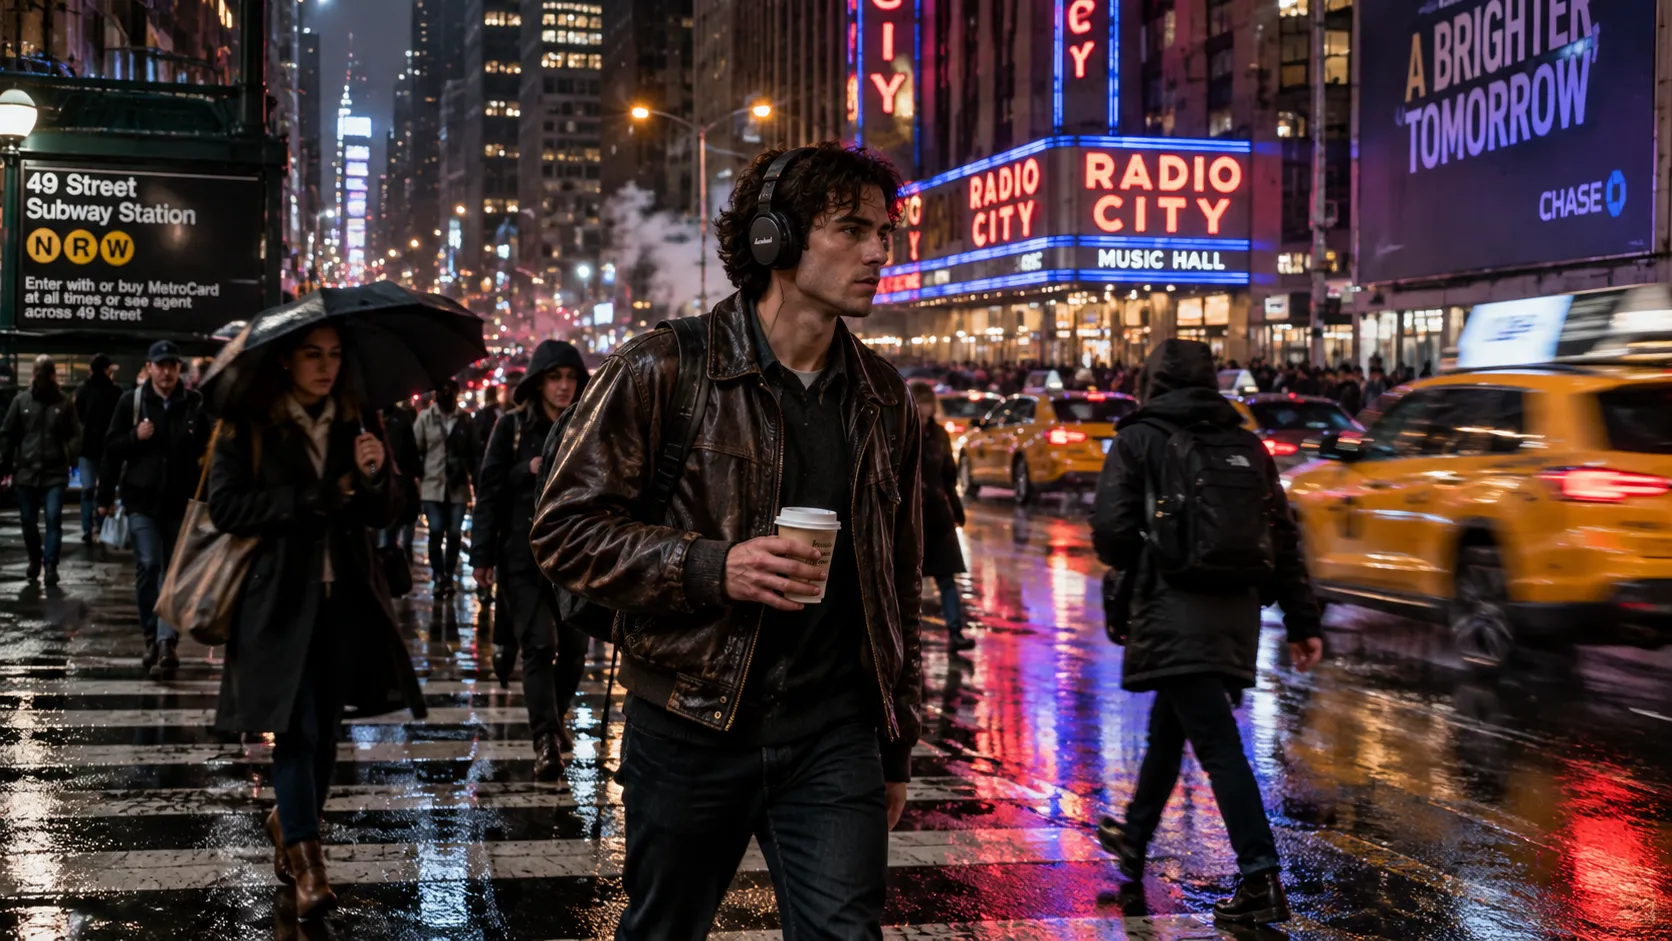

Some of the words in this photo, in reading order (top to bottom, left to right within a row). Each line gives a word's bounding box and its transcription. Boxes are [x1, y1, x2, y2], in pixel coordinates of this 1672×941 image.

[1405, 32, 1426, 103] A
[1404, 49, 1591, 174] TOMORROW
[26, 172, 59, 195] 49
[66, 173, 137, 198] Street
[970, 158, 1040, 210] RADIO
[1085, 152, 1242, 193] RADIO
[26, 197, 113, 226] Subway
[119, 201, 196, 225] Station
[1093, 194, 1231, 234] CITY
[1539, 181, 1602, 221] CHASE
[972, 200, 1035, 248] CITY
[35, 236, 52, 256] N
[73, 237, 89, 257] R
[107, 239, 129, 258] W
[1098, 249, 1164, 269] MUSIC
[1172, 251, 1225, 270] HALL
[24, 292, 39, 304] at
[44, 291, 59, 304] all
[64, 292, 101, 305] times
[105, 295, 120, 306] or
[124, 296, 149, 307] see
[153, 296, 192, 310] agent
[25, 276, 63, 290] Enter
[67, 278, 95, 291] with
[99, 281, 115, 292] or
[118, 280, 144, 295] buy
[148, 280, 219, 296] MetroCard
[24, 307, 72, 319] across
[76, 306, 95, 320] 49
[100, 306, 142, 321] Street
